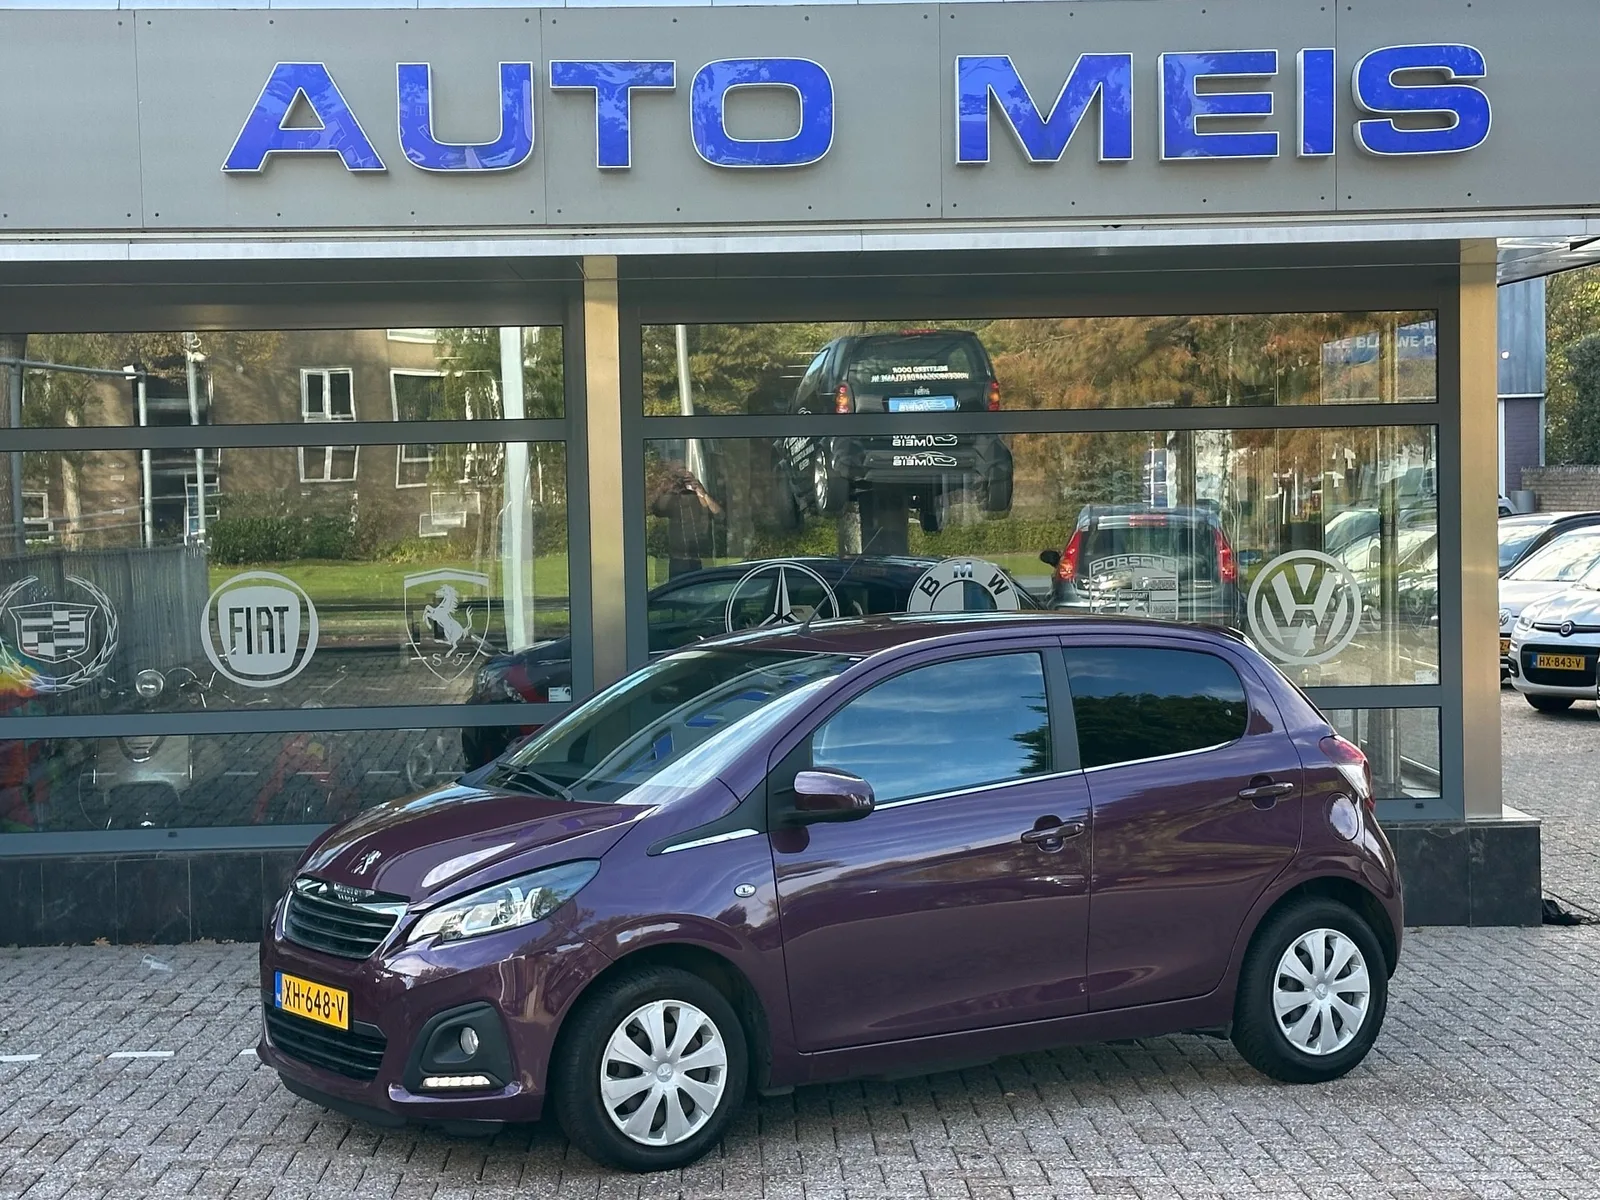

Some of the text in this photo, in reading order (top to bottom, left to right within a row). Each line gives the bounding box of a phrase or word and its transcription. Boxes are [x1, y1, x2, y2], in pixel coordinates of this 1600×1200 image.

[220, 43, 1493, 174] AUTO MEIS
[919, 561, 1009, 598] BMW
[228, 605, 289, 655] FIAT
[1540, 656, 1581, 668] HX-843-V
[284, 979, 344, 1022] XH-648-V
